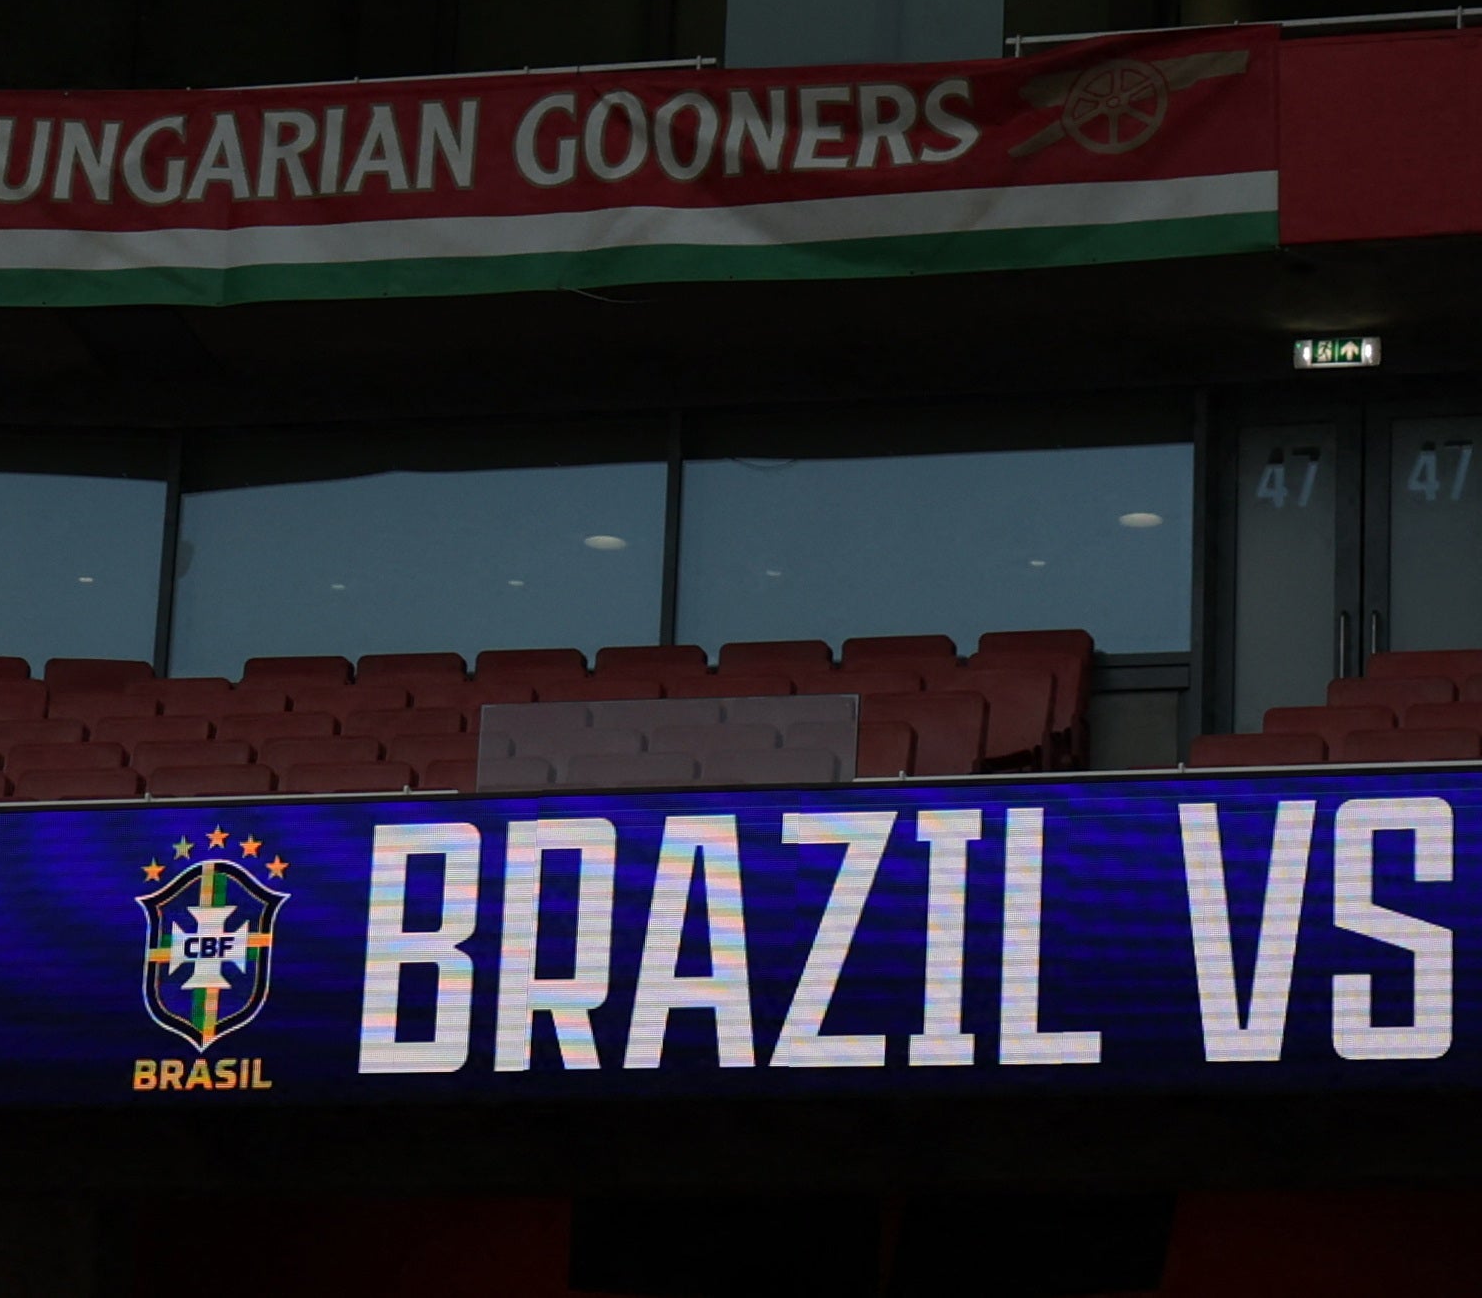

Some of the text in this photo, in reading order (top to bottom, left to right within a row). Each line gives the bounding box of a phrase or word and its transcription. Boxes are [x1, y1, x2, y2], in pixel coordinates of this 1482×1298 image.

[514, 77, 982, 189] GOONERS
[1256, 447, 1321, 508] 47
[1407, 440, 1473, 501] 47
[185, 937, 235, 958] CBF
[357, 807, 1101, 1075] BRAZIL
[1178, 796, 1454, 1062] VS
[132, 1057, 274, 1092] BRASIL
